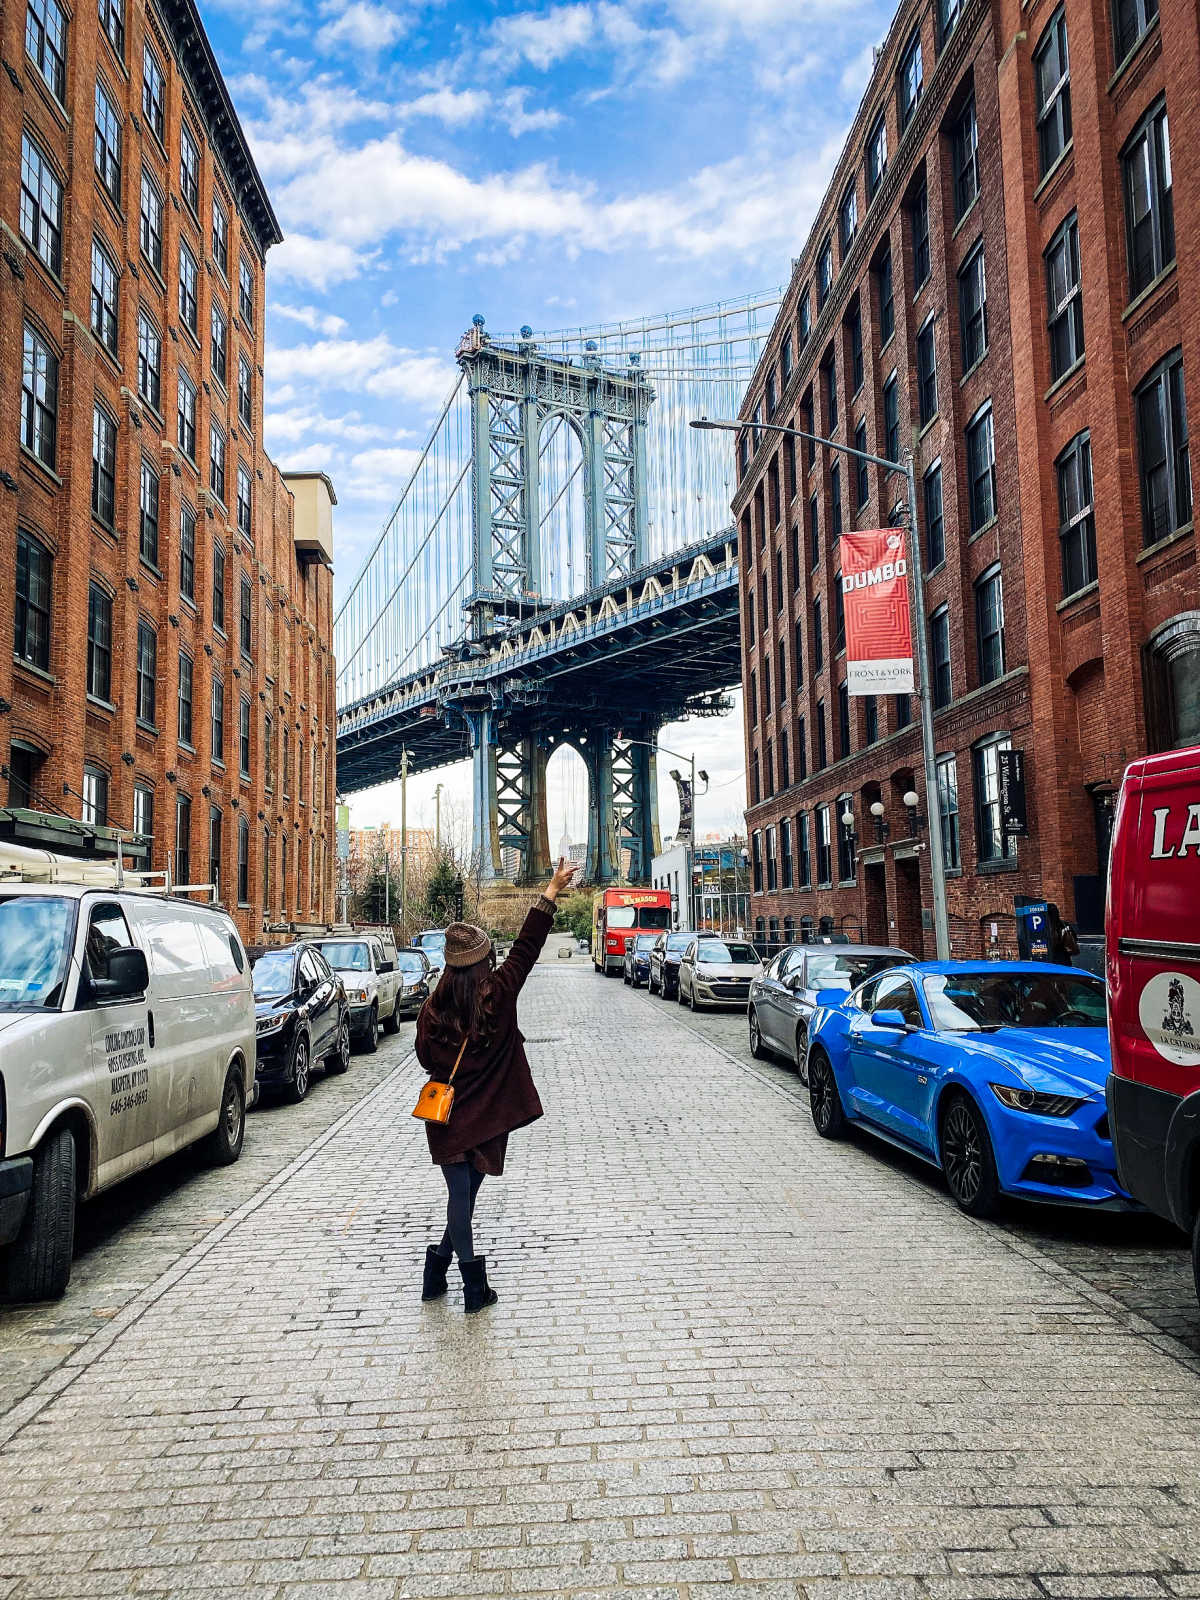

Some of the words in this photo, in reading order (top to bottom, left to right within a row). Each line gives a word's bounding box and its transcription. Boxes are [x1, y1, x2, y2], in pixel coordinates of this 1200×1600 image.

[842, 559, 907, 593] DUMBO
[1001, 755, 1009, 765] 25
[1001, 766, 1010, 804] Washington
[1150, 804, 1200, 859] LA
